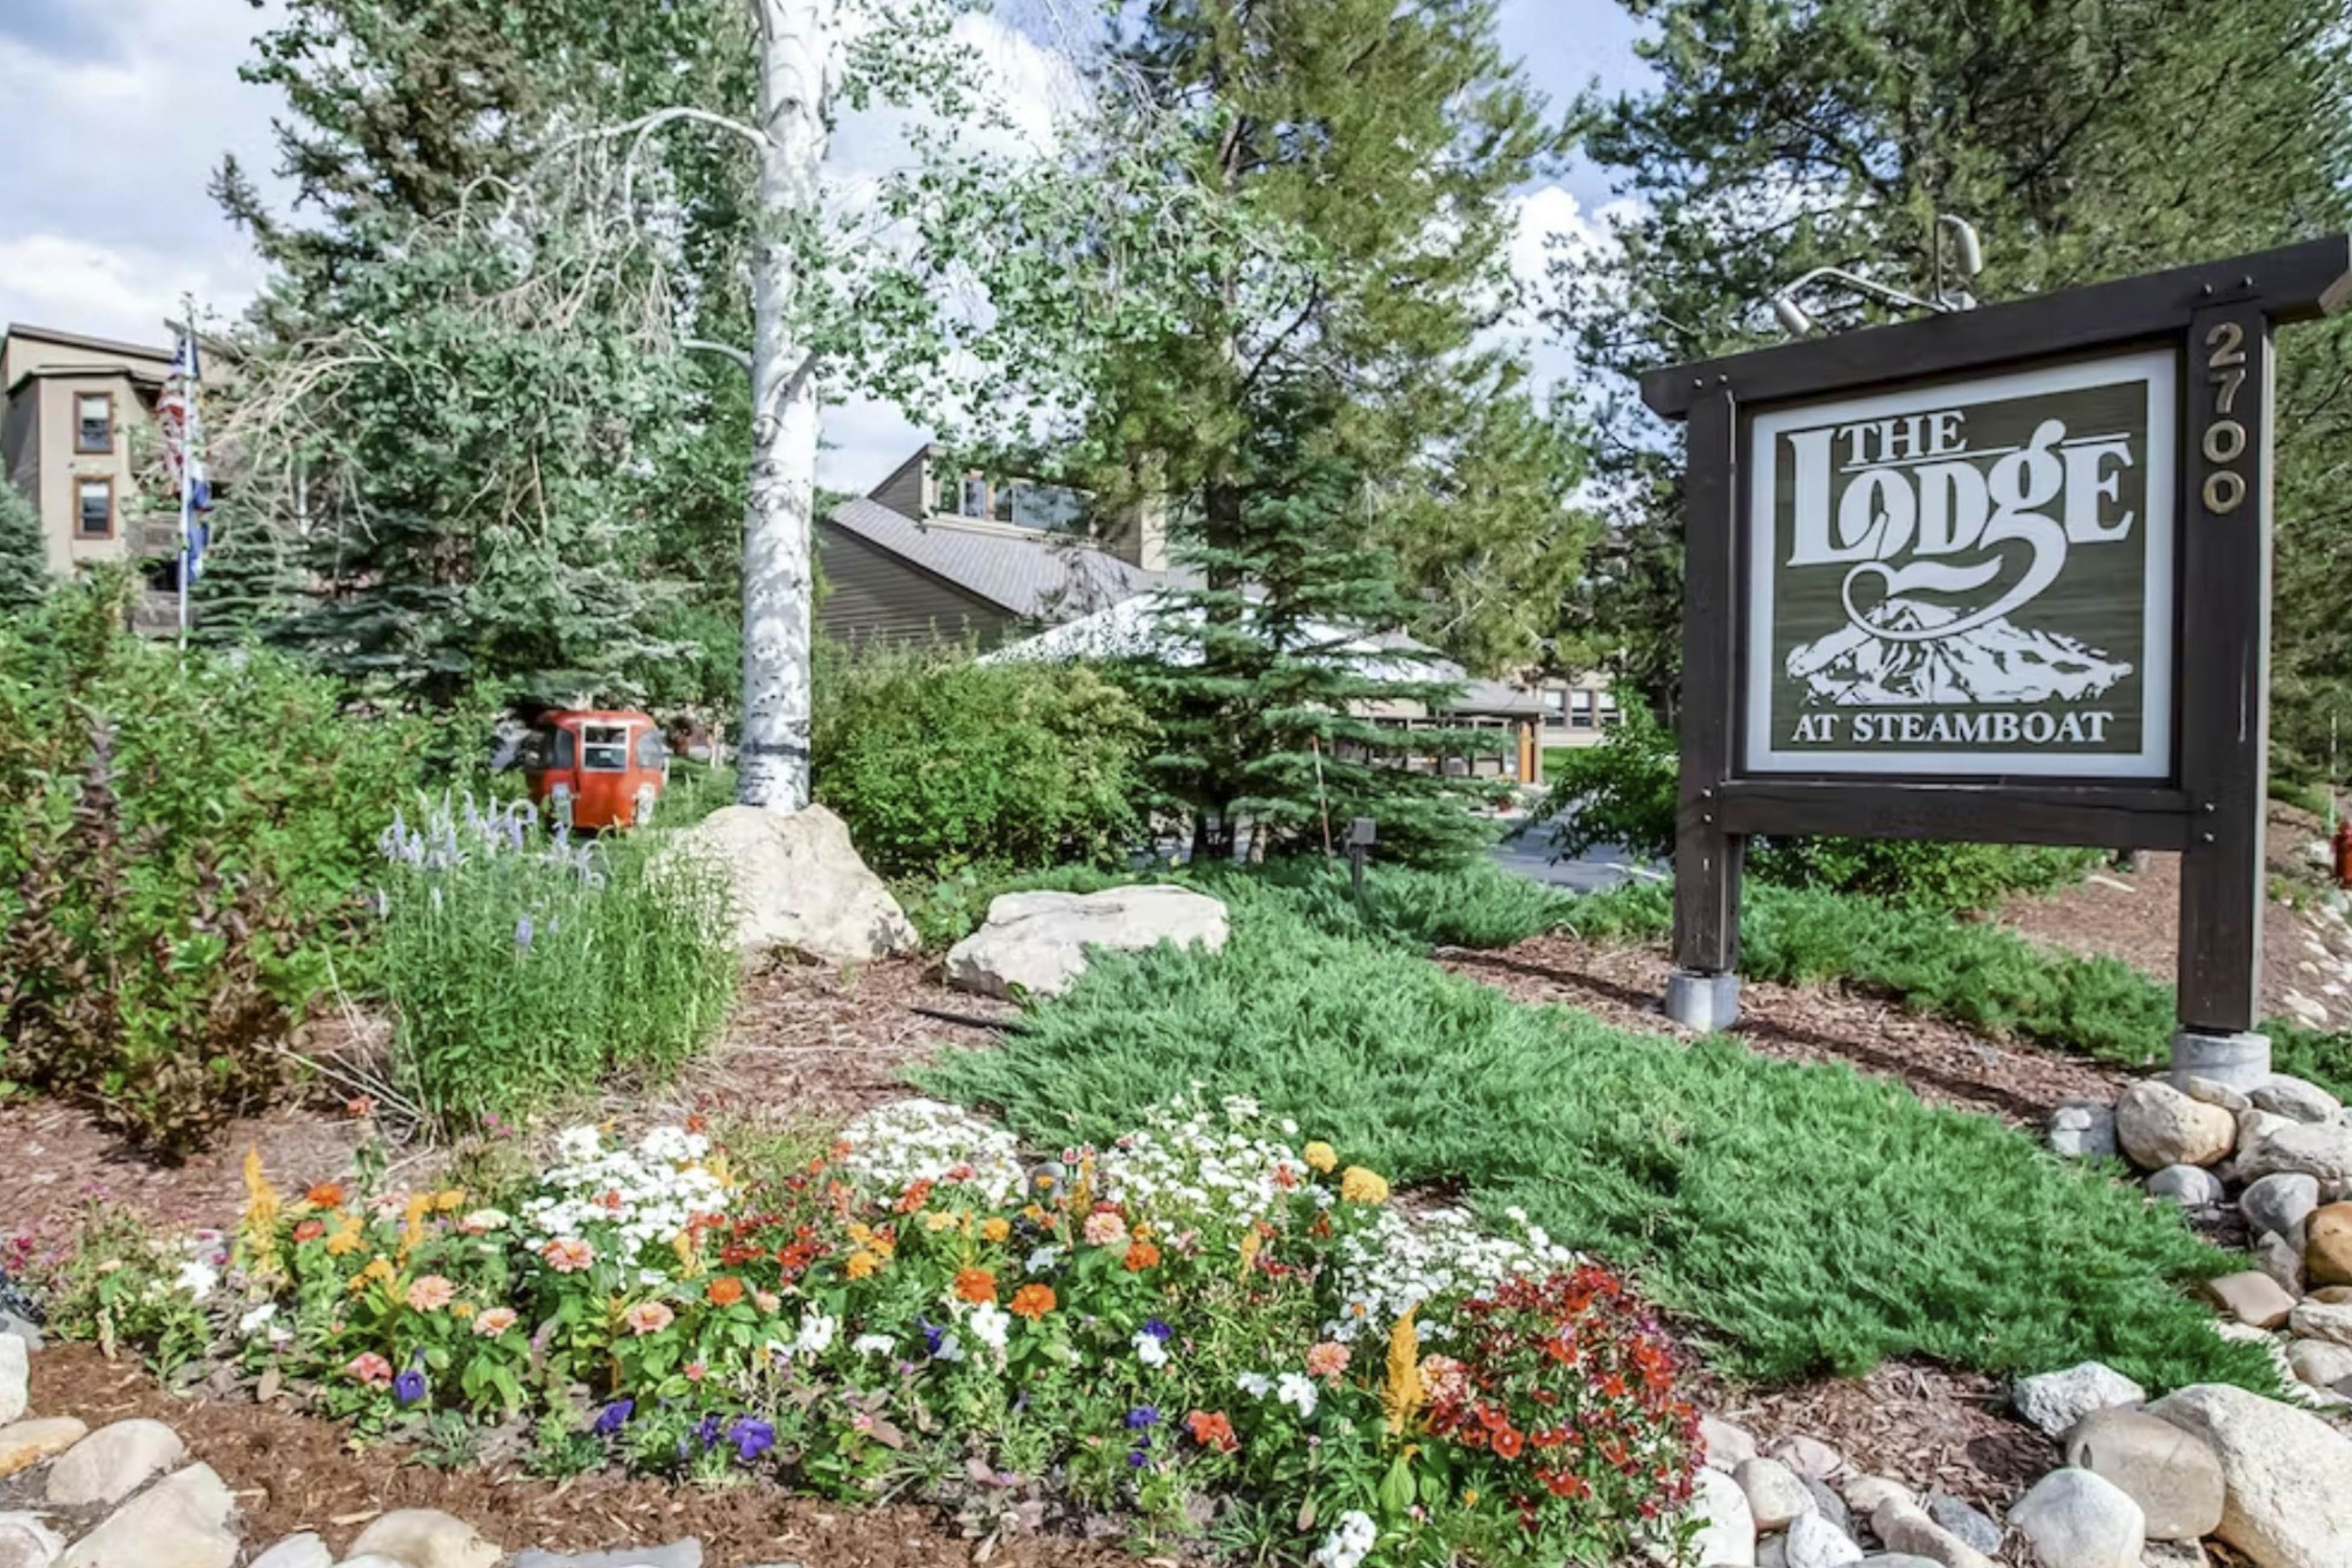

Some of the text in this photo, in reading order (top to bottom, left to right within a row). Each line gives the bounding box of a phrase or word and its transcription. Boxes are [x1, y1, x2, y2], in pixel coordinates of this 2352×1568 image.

[1839, 411, 1967, 465] THE
[2203, 323, 2246, 513] 2700
[1792, 710, 2113, 742] AT STEAMBOAT
